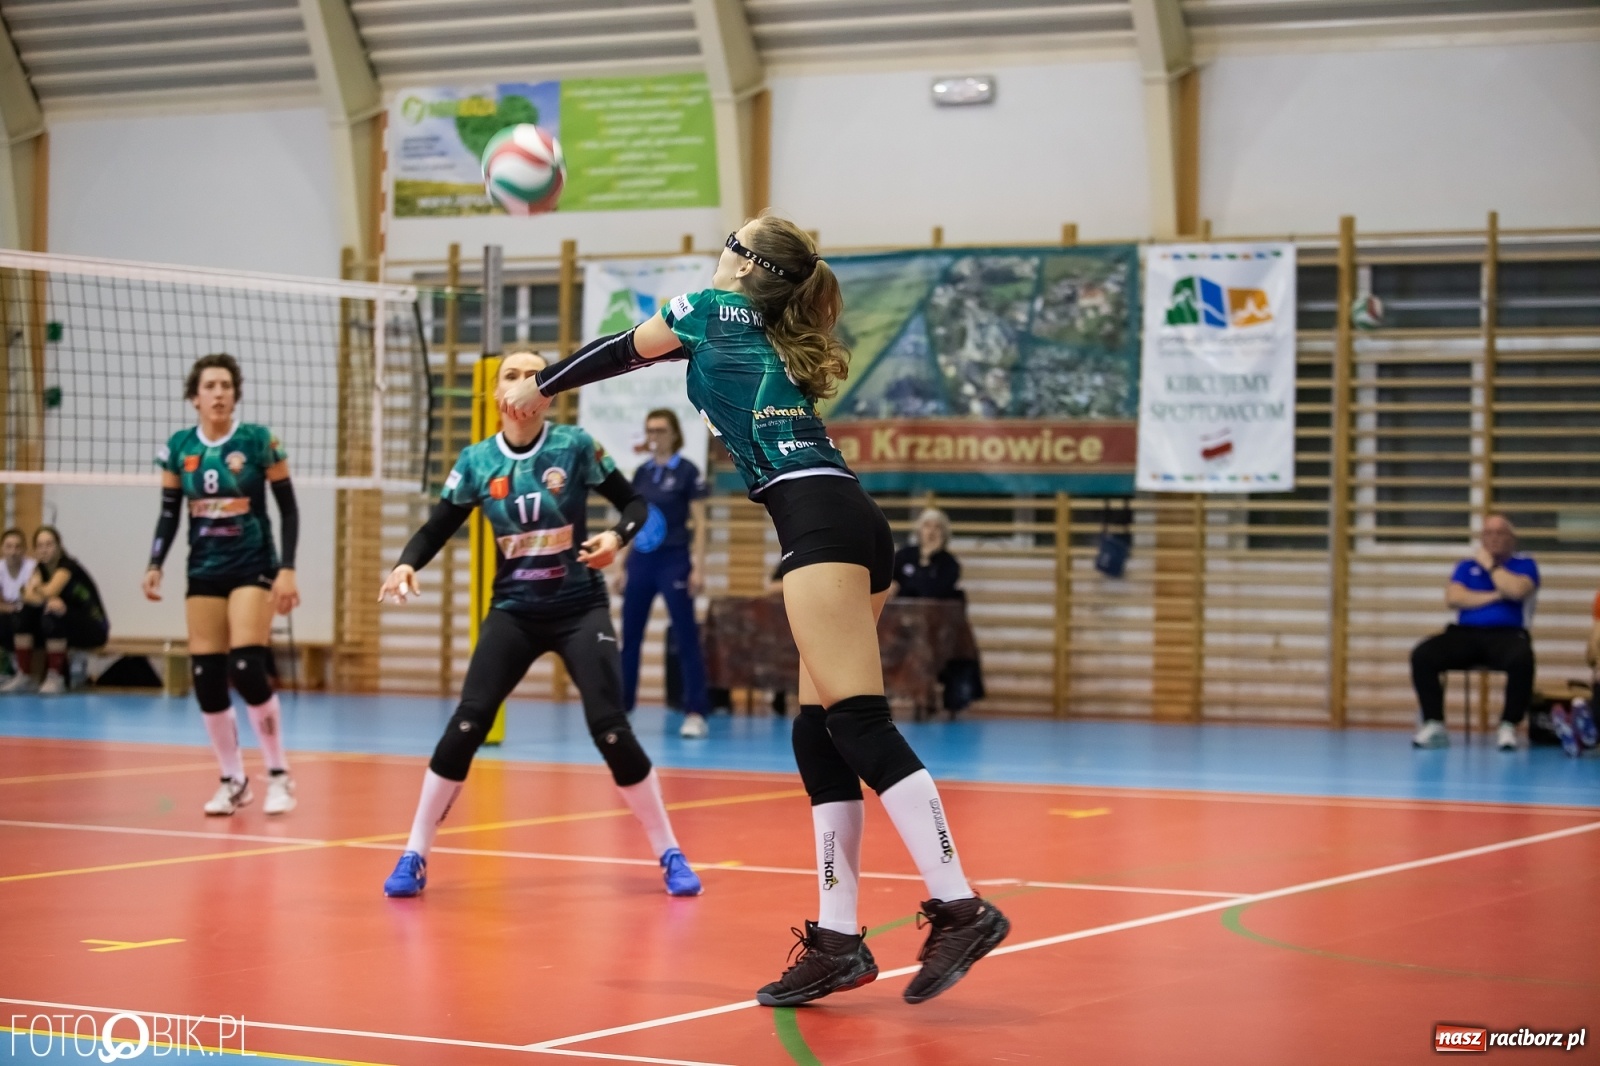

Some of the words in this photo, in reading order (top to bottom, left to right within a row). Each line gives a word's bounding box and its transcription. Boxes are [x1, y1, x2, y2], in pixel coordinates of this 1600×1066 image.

[745, 250, 785, 276] SZIOLS
[719, 305, 750, 324] UKS
[872, 427, 1103, 463] Krzanowice
[203, 469, 219, 494] 8
[514, 492, 542, 524] 17
